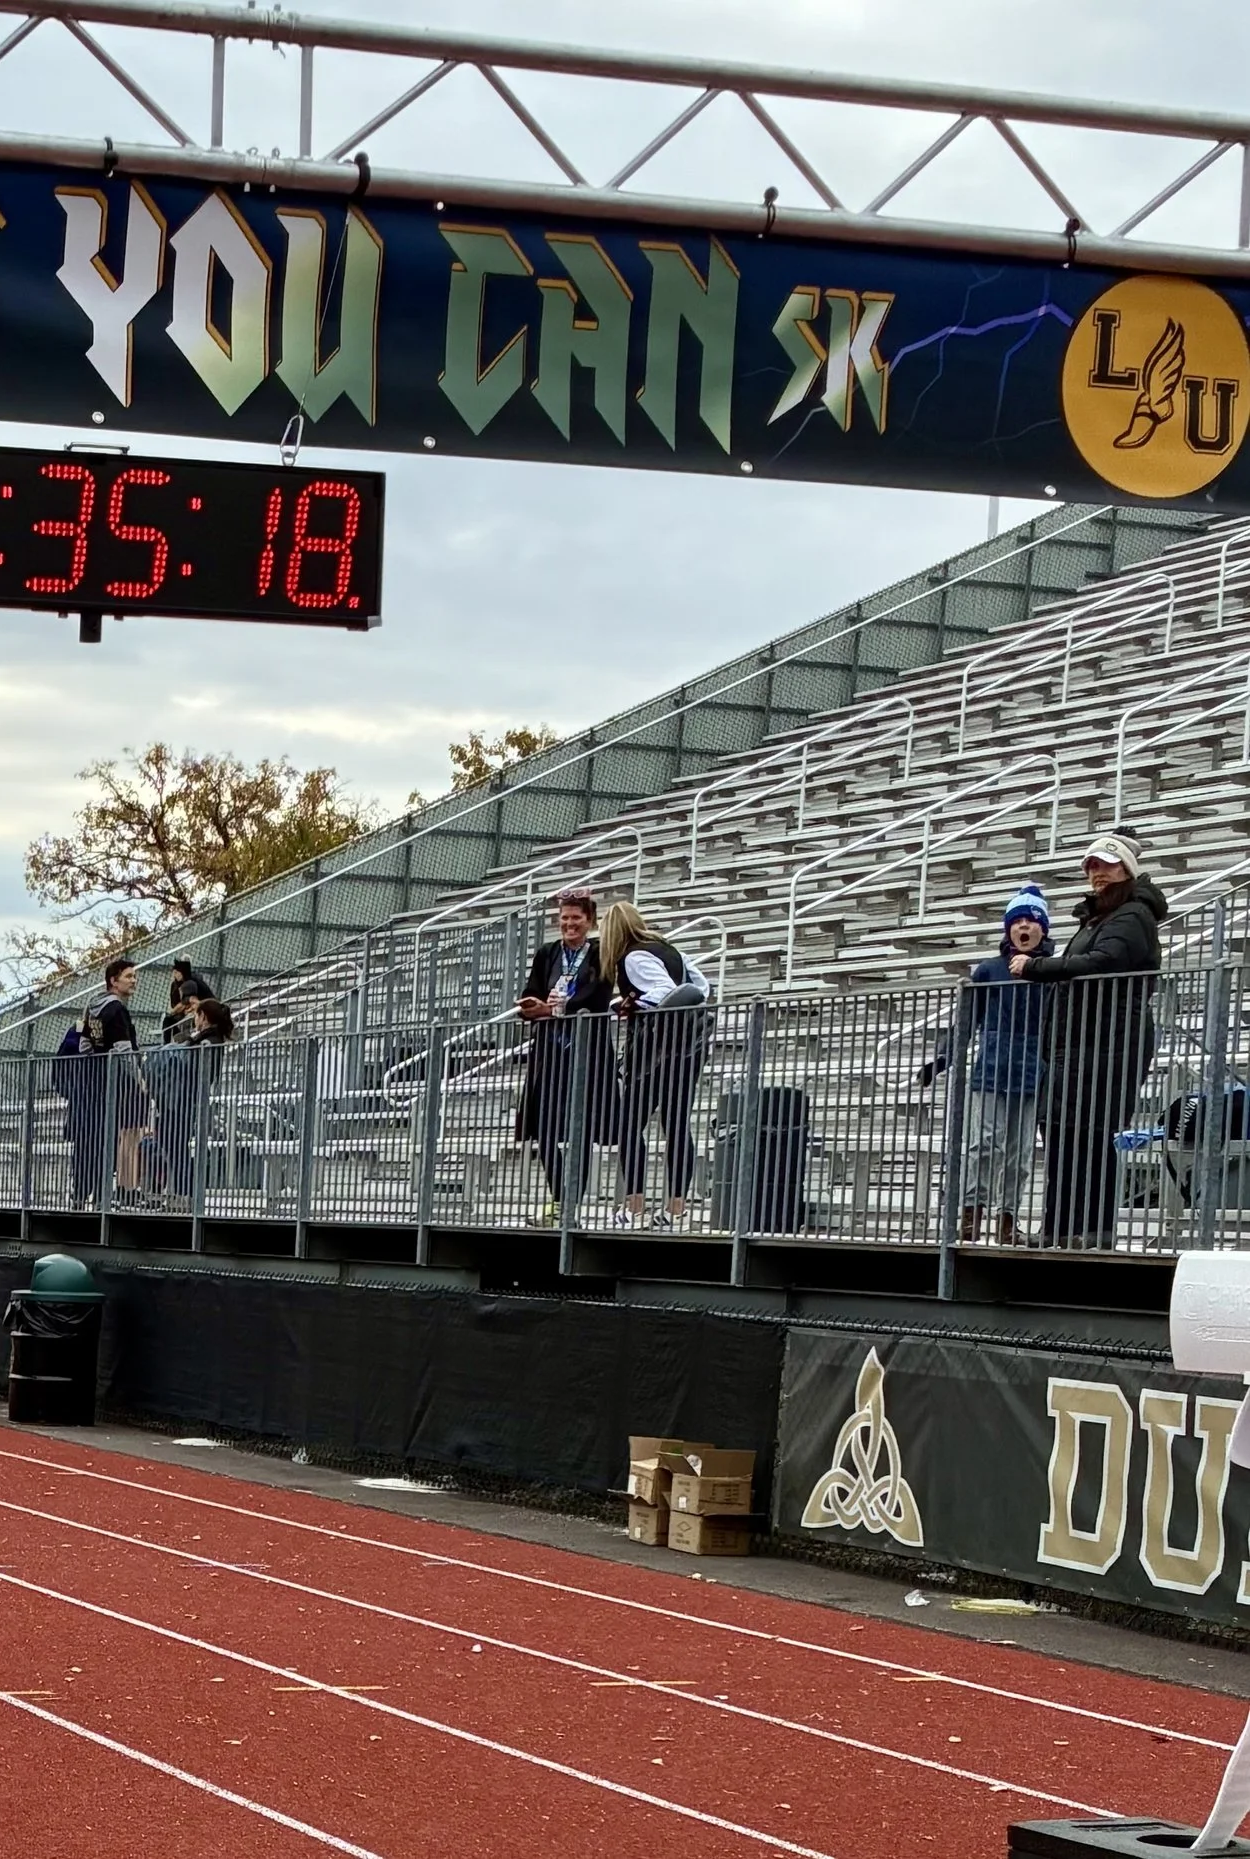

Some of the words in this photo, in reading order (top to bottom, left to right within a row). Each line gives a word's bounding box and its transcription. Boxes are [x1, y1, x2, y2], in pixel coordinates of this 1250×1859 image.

[55, 179, 384, 426] YOU
[438, 222, 740, 454] CAN
[1037, 1377, 1250, 1604] DU
